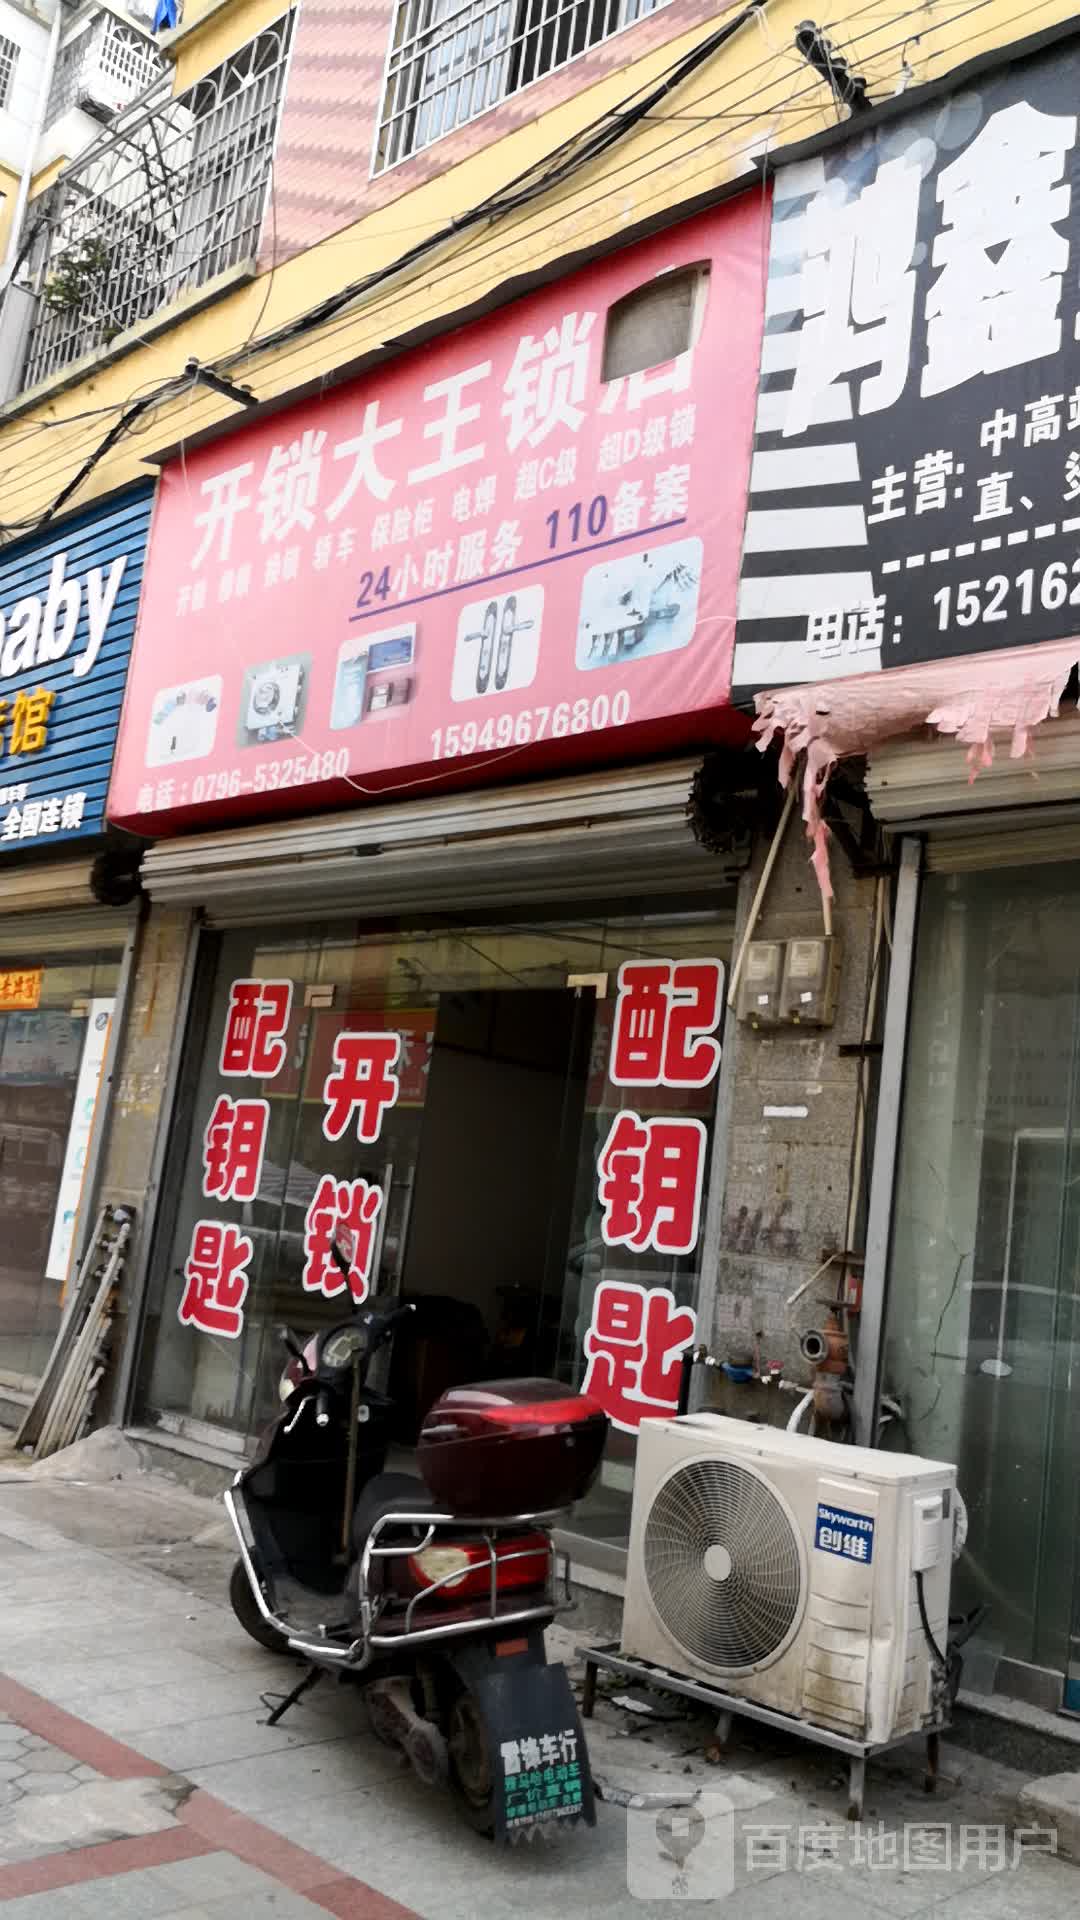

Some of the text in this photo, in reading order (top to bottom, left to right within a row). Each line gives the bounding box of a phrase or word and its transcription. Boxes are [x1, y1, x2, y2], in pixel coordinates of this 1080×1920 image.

[782, 100, 1080, 437] 鸿鑫
[356, 519, 523, 608] 24小时服务
[546, 463, 691, 548] 110备案
[370, 498, 434, 551] 保险柜
[513, 446, 577, 501] 超C级
[597, 404, 696, 472] 超D级锁
[0, 551, 128, 677] aby
[0, 687, 56, 756] 馆
[431, 689, 630, 760] 15949676800
[178, 978, 294, 1339] 配钥匙
[303, 1032, 401, 1304] 开锁
[580, 957, 726, 1436] 配钥匙
[819, 1508, 873, 1532] Skyworth
[819, 1526, 868, 1559] 创维
